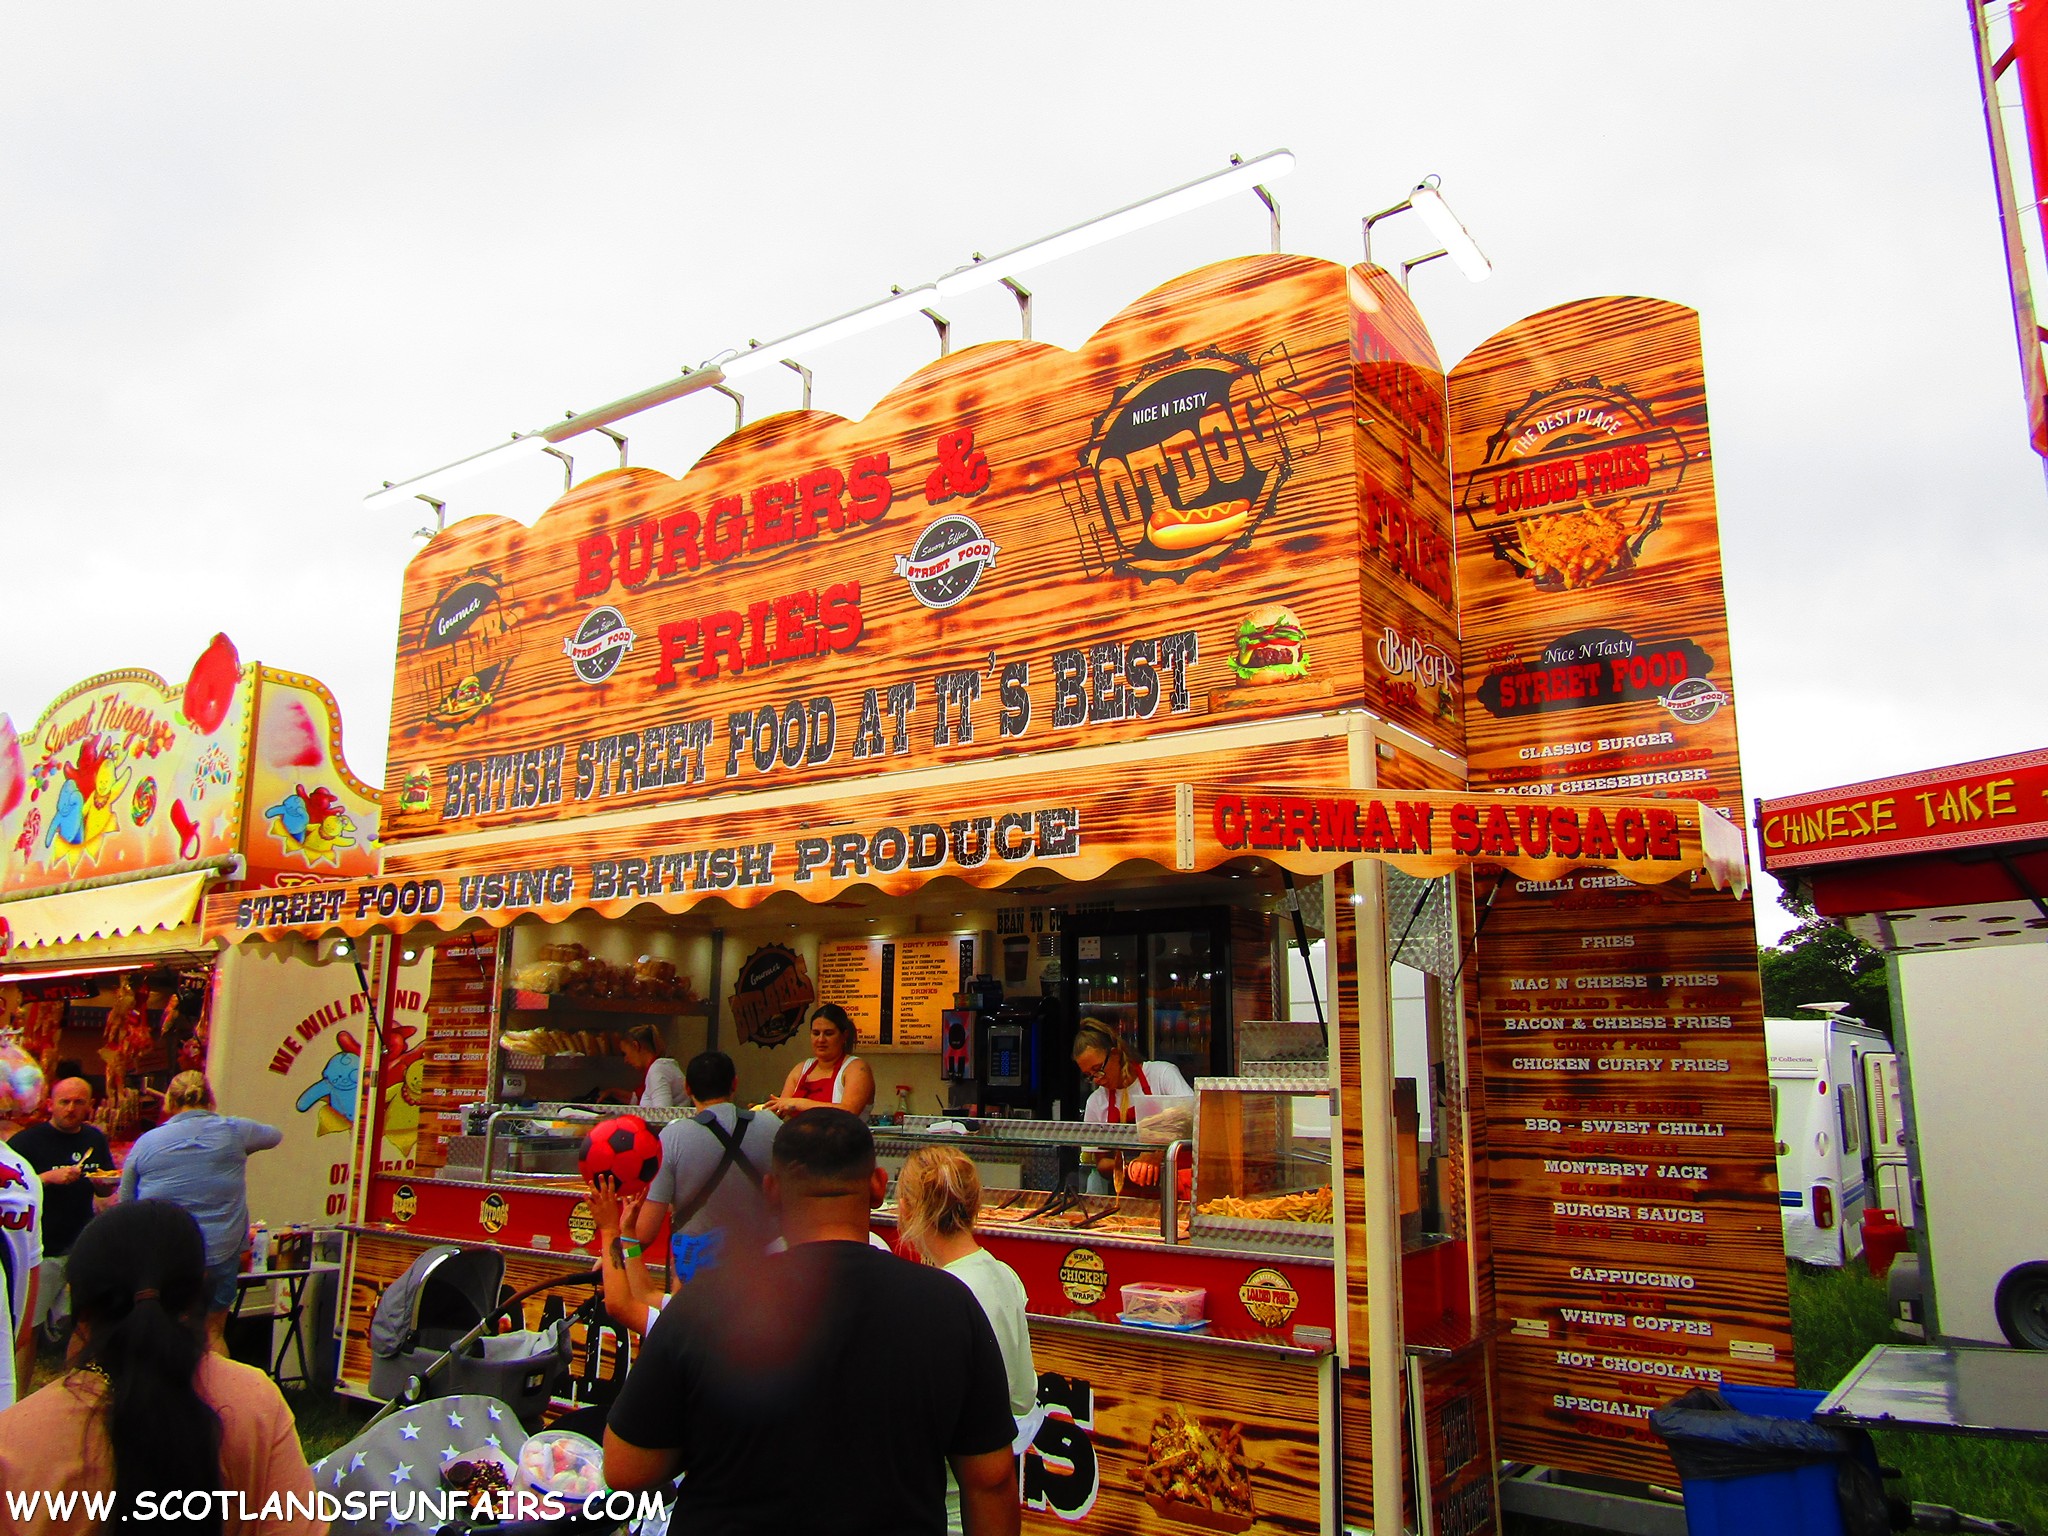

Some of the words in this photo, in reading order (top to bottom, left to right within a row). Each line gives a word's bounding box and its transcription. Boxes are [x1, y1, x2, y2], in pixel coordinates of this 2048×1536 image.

[1131, 402, 1158, 427] NICE
[1160, 400, 1171, 419] N
[1172, 391, 1208, 416] TASTY
[1512, 429, 1537, 457] THE
[1536, 409, 1573, 436] BEST
[1576, 408, 1622, 437] PLACE
[1493, 459, 1578, 515] LOADED
[1583, 444, 1650, 497] FRIES
[574, 453, 893, 601] BURGERS
[925, 427, 991, 504] &
[1363, 465, 1453, 613] FRIES
[908, 558, 950, 578] STREET
[958, 545, 990, 561] FOOD
[438, 598, 481, 636] Gourmet
[573, 642, 603, 658] STREET
[608, 632, 630, 645] FOOD
[655, 579, 864, 689] FRIES
[1377, 627, 1460, 694] BURGER
[1545, 648, 1574, 664] Nice
[1579, 644, 1593, 658] N
[1596, 637, 1634, 658] Tasty
[1501, 663, 1602, 708] STREET
[1610, 650, 1688, 693] FOOD
[1667, 699, 1696, 710] STREET
[1701, 693, 1723, 703] FOOD
[44, 700, 95, 759] Sweet
[98, 692, 155, 750] Things
[443, 741, 566, 821] BRITISH
[574, 717, 714, 800] STREET
[725, 696, 837, 777] FOOD
[853, 681, 916, 760] AT
[933, 650, 1030, 748] IT'S
[1051, 630, 1199, 729] BEST
[1519, 741, 1592, 760] CLASSIC
[1597, 732, 1673, 751] BURGER
[1487, 761, 1559, 783] CLASSIC
[1565, 748, 1713, 775] CHEESEBURGER
[1559, 768, 1708, 794] CHEESEBURGER
[1763, 797, 1897, 849] CHINESE
[1915, 777, 2017, 829] TAKE
[1212, 794, 1433, 855] GERMAN
[1450, 801, 1681, 862] SAUSAGE
[235, 888, 347, 930] STREET
[355, 878, 445, 921] FOOD
[459, 865, 576, 914] USING
[589, 840, 774, 900] BRITISH
[794, 807, 1080, 886] PRODUCE
[1516, 878, 1574, 893] CHILLI
[1579, 876, 1637, 889] CHEE
[997, 912, 1024, 934] BEAN
[1030, 911, 1043, 932] TO
[1581, 935, 1635, 948] FRIES
[750, 963, 780, 986] Gourmet
[1510, 978, 1549, 990] MAC
[1555, 978, 1569, 990] N
[1575, 975, 1647, 989] CHEESE
[1661, 974, 1719, 987] FRIES
[1495, 999, 1530, 1012] BBQ
[1536, 997, 1609, 1011] PULLED
[1614, 996, 1669, 1010] PORK
[1504, 1018, 1565, 1030] BACON
[1572, 1018, 1586, 1030] &
[1592, 1017, 1667, 1029] CHEESE
[1674, 1016, 1732, 1029] FRIES
[268, 1035, 304, 1076] WE
[296, 999, 348, 1038] WILL
[1553, 1038, 1617, 1050] CURRY
[1624, 1038, 1681, 1050] FRIES
[1512, 1058, 1591, 1071] CHICKEN
[1597, 1058, 1664, 1071] CURRY
[1670, 1059, 1730, 1072] FRIES
[1525, 1119, 1562, 1133] BBQ
[1581, 1120, 1650, 1135] SWEET
[1657, 1122, 1724, 1137] CHILLI
[1543, 1160, 1649, 1178] MONTEREY
[1656, 1165, 1709, 1180] JACK
[1560, 1182, 1611, 1197] BLUE
[1617, 1184, 1694, 1201] CHEESE
[1553, 1202, 1631, 1219] BURGER
[1637, 1208, 1704, 1223] SAUCE
[1060, 1269, 1108, 1285] CHICKEN
[1569, 1266, 1695, 1289] CAPPUCCINO
[1072, 1291, 1094, 1300] WRAPS
[1560, 1309, 1626, 1328] WHITE
[1632, 1315, 1713, 1337] COFFEE
[1556, 1352, 1596, 1369] HOT
[1602, 1357, 1722, 1382] CHOCOLATE
[1553, 1395, 1654, 1419] SPECIALIT
